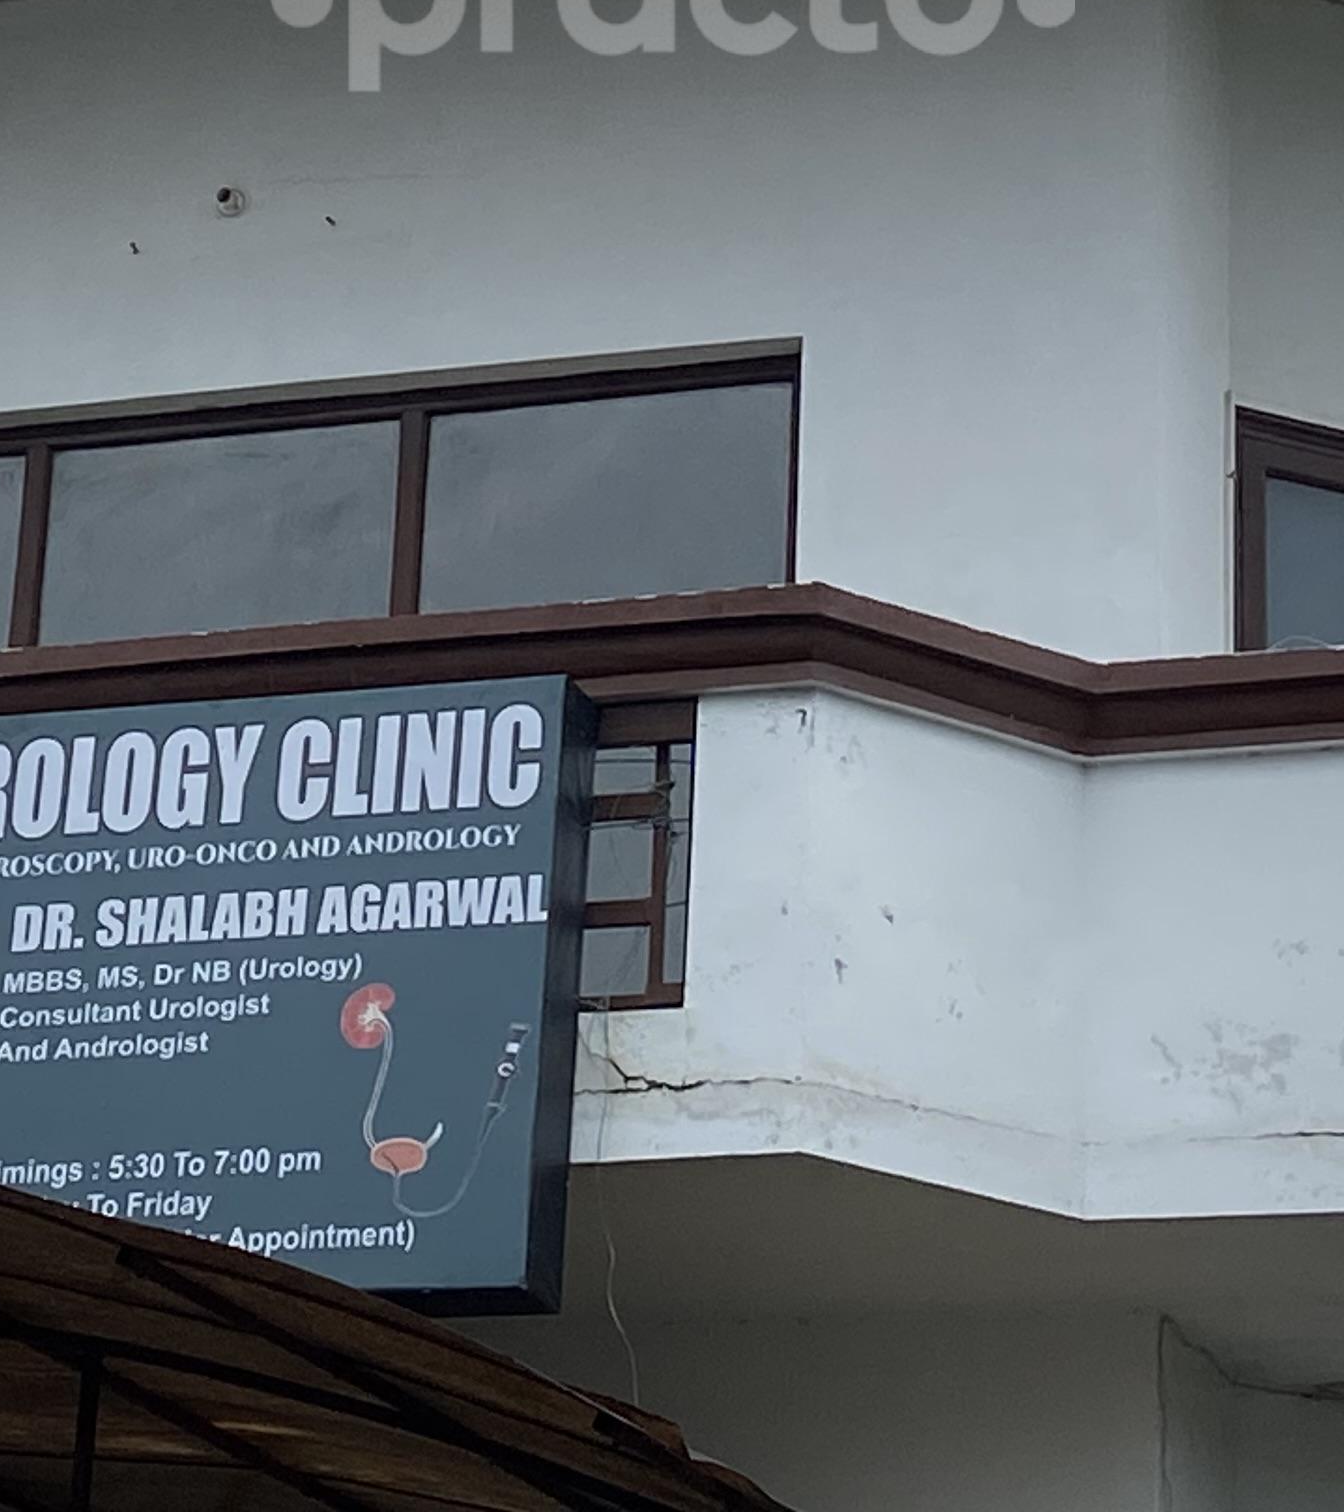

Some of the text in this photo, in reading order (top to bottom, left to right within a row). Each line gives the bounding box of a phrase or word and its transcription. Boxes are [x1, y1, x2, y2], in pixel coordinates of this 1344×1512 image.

[276, 703, 543, 822] CLINIC
[128, 838, 277, 871] URO-ONCO
[282, 836, 340, 861] AND
[346, 824, 521, 857] ANDROLOGY
[11, 874, 548, 952] DR. SHALABH AGARWAL
[3, 953, 362, 993] MBBS, MS, Dr NB (Urology)
[0, 993, 270, 1028] Consultant Urologist
[53, 1031, 209, 1059] Andrologist
[109, 1153, 164, 1180] 5:30
[174, 1150, 205, 1177] To
[214, 1148, 270, 1175] 7:00
[279, 1150, 321, 1178] pm
[86, 1194, 119, 1218] To
[126, 1190, 213, 1221] Friday
[228, 1219, 415, 1257] Appointment)
